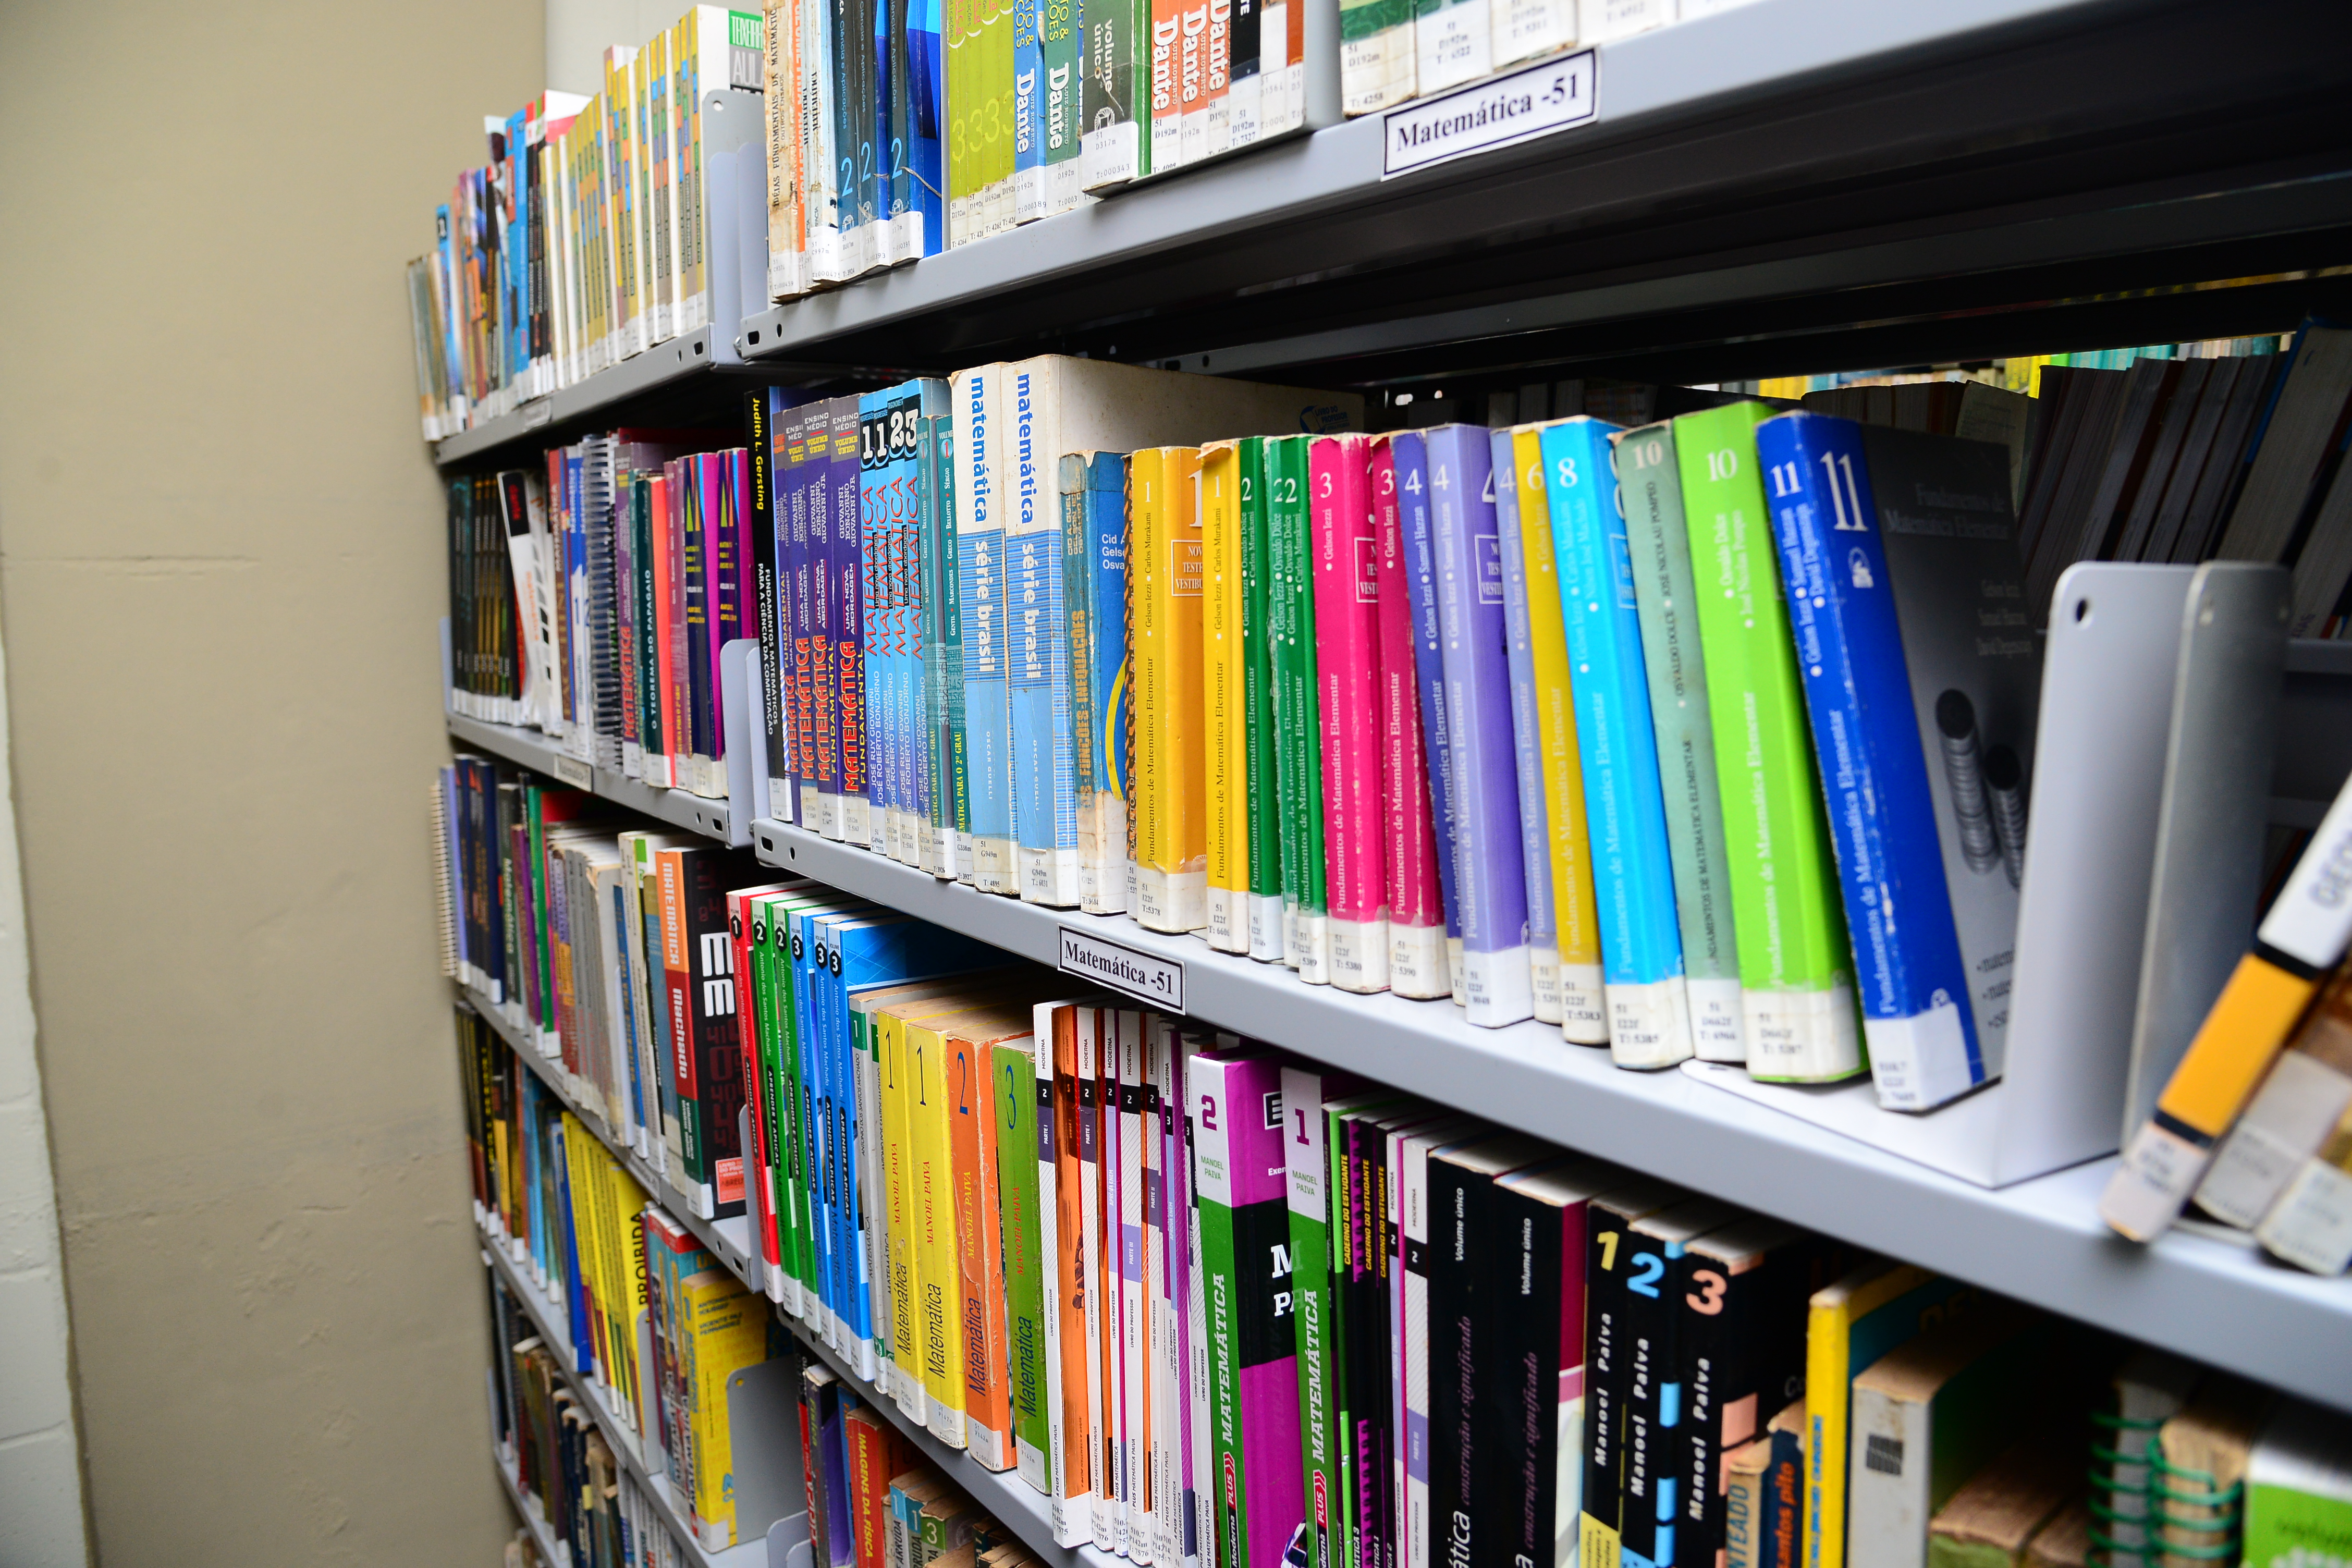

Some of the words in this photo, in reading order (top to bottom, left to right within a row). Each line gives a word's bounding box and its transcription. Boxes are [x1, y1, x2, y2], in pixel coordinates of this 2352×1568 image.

[1105, 19, 1113, 92] volume
[1153, 15, 1179, 111] Dante
[1182, 4, 1207, 103] Dante
[772, 95, 780, 169] FUNDAMENTAIS
[970, 109, 982, 153] 3
[985, 99, 999, 143] 3
[1017, 68, 1035, 153] Dante
[1049, 63, 1069, 150] Dante
[1396, 94, 1533, 152] Matemática
[1541, 72, 1579, 105] -51
[891, 138, 903, 179] 2
[1155, 128, 1177, 139] D192m
[861, 142, 871, 182] 2
[772, 177, 780, 207] IDÉIAS
[753, 398, 762, 438] Judith
[832, 412, 859, 425] ENSINO
[835, 421, 858, 432] MÉDIO
[835, 435, 858, 447] VOLUME
[863, 425, 874, 460] 1
[890, 411, 904, 449] 2
[905, 408, 918, 447] 3
[755, 442, 762, 452] L.
[837, 444, 855, 455] ÚNICO
[971, 376, 990, 522] matemática
[1018, 373, 1037, 524] matemática
[1558, 457, 1578, 488] 8
[1706, 448, 1738, 483] 10
[756, 456, 765, 511] Gersting
[1145, 481, 1151, 503] 1
[1214, 475, 1221, 498] 1
[1241, 477, 1252, 501] 2
[1284, 477, 1297, 504] 2
[1320, 472, 1333, 498] 3
[1381, 468, 1394, 495] 3
[1405, 468, 1423, 496] 4
[1527, 461, 1545, 491] 6
[1771, 460, 1804, 498] 11
[1820, 450, 1870, 532] 11
[862, 486, 877, 656] MATEMÁTICA
[890, 476, 906, 656] MATEMÁTICA
[906, 476, 922, 660] MATEMÁTICA
[976, 541, 993, 599] série
[1022, 543, 1042, 604] série
[765, 569, 774, 648] FUNDAMENTOS
[763, 646, 769, 661] DA
[978, 605, 995, 672] brasil
[1023, 609, 1043, 678] brasil
[764, 664, 774, 735] COMPUTAÇÃO
[769, 650, 778, 726] MATEMÁTICOS
[795, 638, 815, 780] MATEMÁTICA
[813, 634, 830, 782] MATEMÁTICA
[1216, 660, 1224, 718] Elementar
[1330, 672, 1341, 737] Elementar
[840, 641, 860, 792] MATEMÁTICA
[858, 648, 866, 784] FUNDAMENTAL
[1216, 721, 1224, 787] Matemática
[1331, 738, 1343, 811] Matemática
[1148, 779, 1155, 791] de
[1217, 789, 1224, 803] de
[1217, 805, 1225, 880] Fundamentos
[1334, 813, 1343, 829] de
[1336, 831, 1346, 913] Fundamentos
[756, 927, 764, 941] 2
[794, 939, 801, 956] 3
[831, 956, 839, 973] 3
[1065, 940, 1146, 985] Matemática
[1150, 971, 1173, 995] -51
[886, 1029, 894, 1090] 1
[917, 1044, 926, 1106] 1
[957, 1051, 969, 1116] 2
[1005, 1064, 1017, 1130] 3
[1200, 1094, 1217, 1131] 2
[1295, 1108, 1310, 1146] 1
[922, 1160, 932, 1194] PAIVA
[963, 1170, 972, 1204] PAIVA
[1201, 1155, 1224, 1171] MANOEL
[1205, 1167, 1221, 1181] PAIVA
[1292, 1170, 1318, 1185] MANOEL
[1296, 1182, 1315, 1196] PAIVA
[925, 1194, 934, 1246] MANOEL
[1011, 1186, 1021, 1221] PAIVA
[1343, 1209, 1350, 1222] DO
[1456, 1187, 1465, 1219] único
[965, 1206, 975, 1260] MANOEL
[1014, 1223, 1025, 1277] MANOEL
[1455, 1220, 1464, 1261] Volume
[1597, 1230, 1619, 1271] 1
[1627, 1252, 1665, 1299] 2
[1685, 1269, 1728, 1316] 3
[927, 1282, 946, 1380] Matemática
[969, 1296, 986, 1398] Matemática
[1597, 1313, 1611, 1373] Paiva
[1018, 1315, 1037, 1418] Matemática
[1213, 1272, 1233, 1446] MATEMÁTICA
[1304, 1289, 1326, 1464] MATEMÁTICA
[1633, 1338, 1649, 1400] Paiva
[1693, 1357, 1710, 1421] Paiva
[1595, 1387, 1609, 1466] Manoel
[858, 1432, 870, 1497] IMAGENS
[1631, 1414, 1646, 1497] Manoel
[1688, 1436, 1707, 1521] Manoel
[862, 1497, 871, 1515] DA
[1317, 1489, 1327, 1524] PLUS
[864, 1518, 874, 1558] FÍSICA
[1231, 1514, 1239, 1567] Moderna
